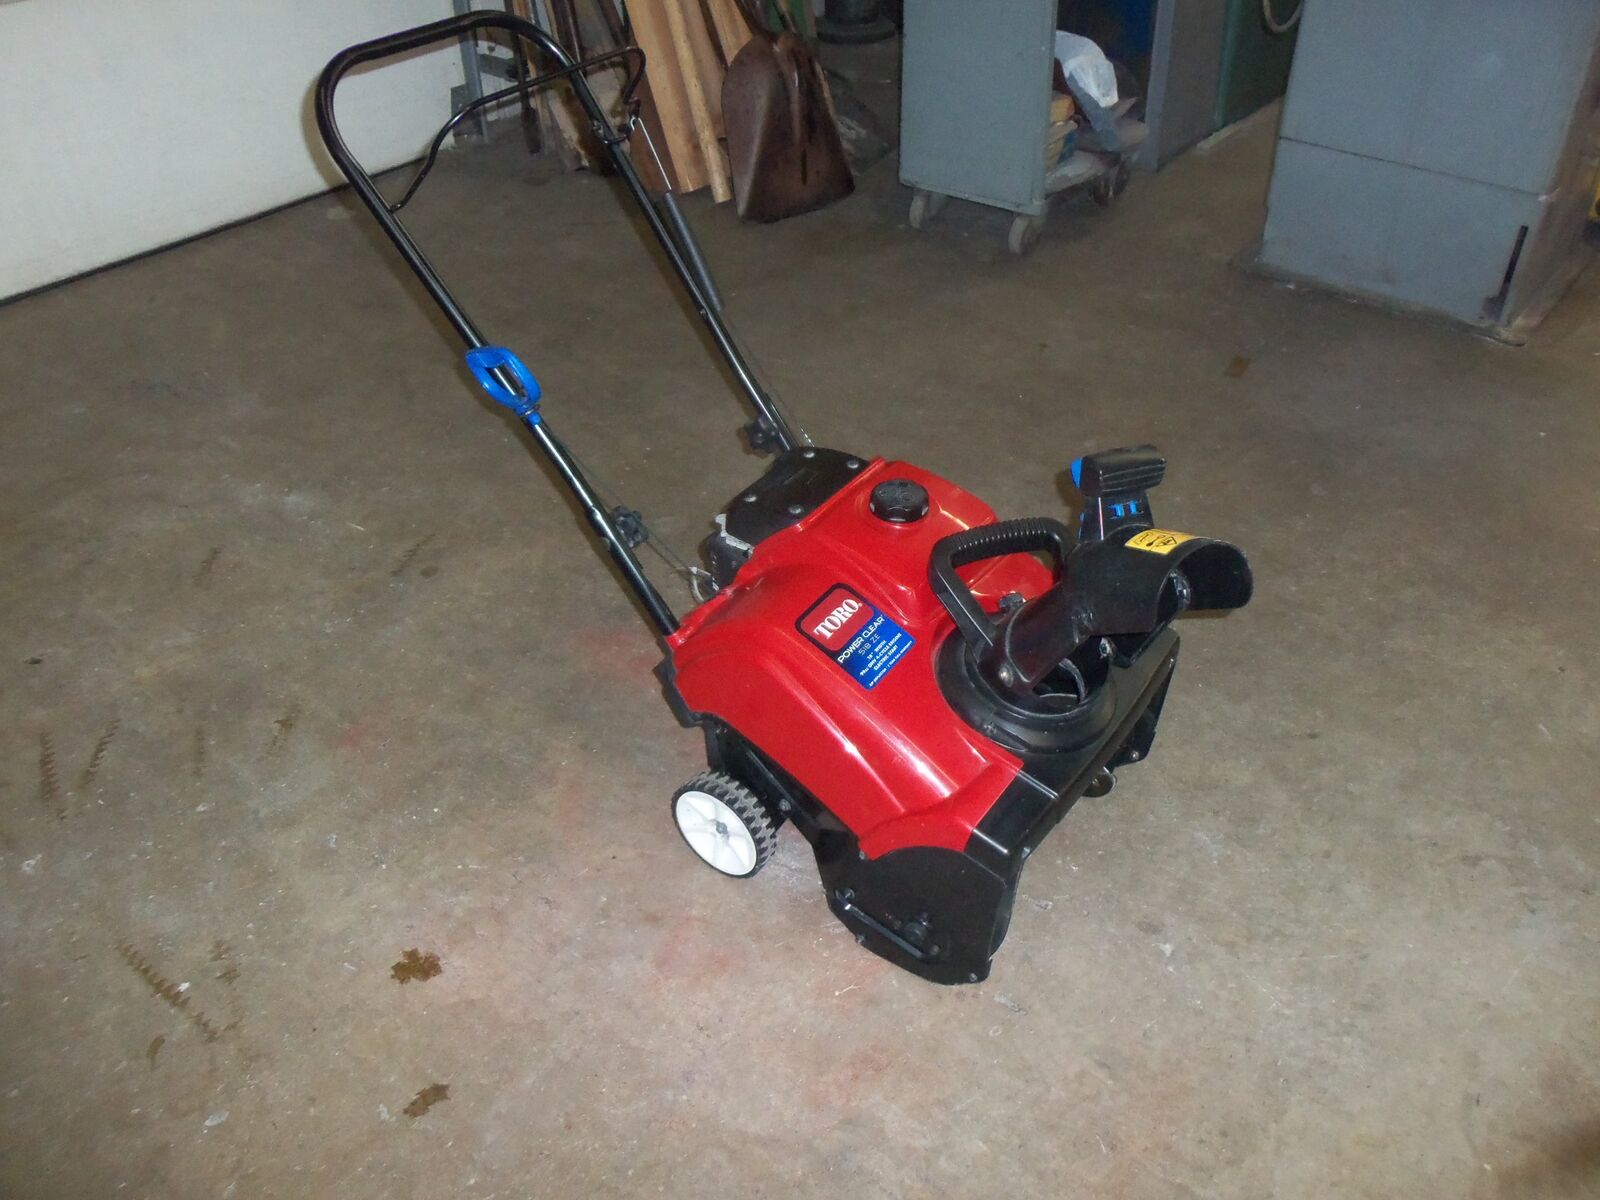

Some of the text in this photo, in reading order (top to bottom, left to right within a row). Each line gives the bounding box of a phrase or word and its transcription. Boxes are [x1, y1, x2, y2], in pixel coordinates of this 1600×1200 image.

[813, 598, 859, 640] TORO
[837, 636, 865, 664] POWER
[862, 615, 885, 638] CLEAR
[858, 633, 881, 656] 518 ZE
